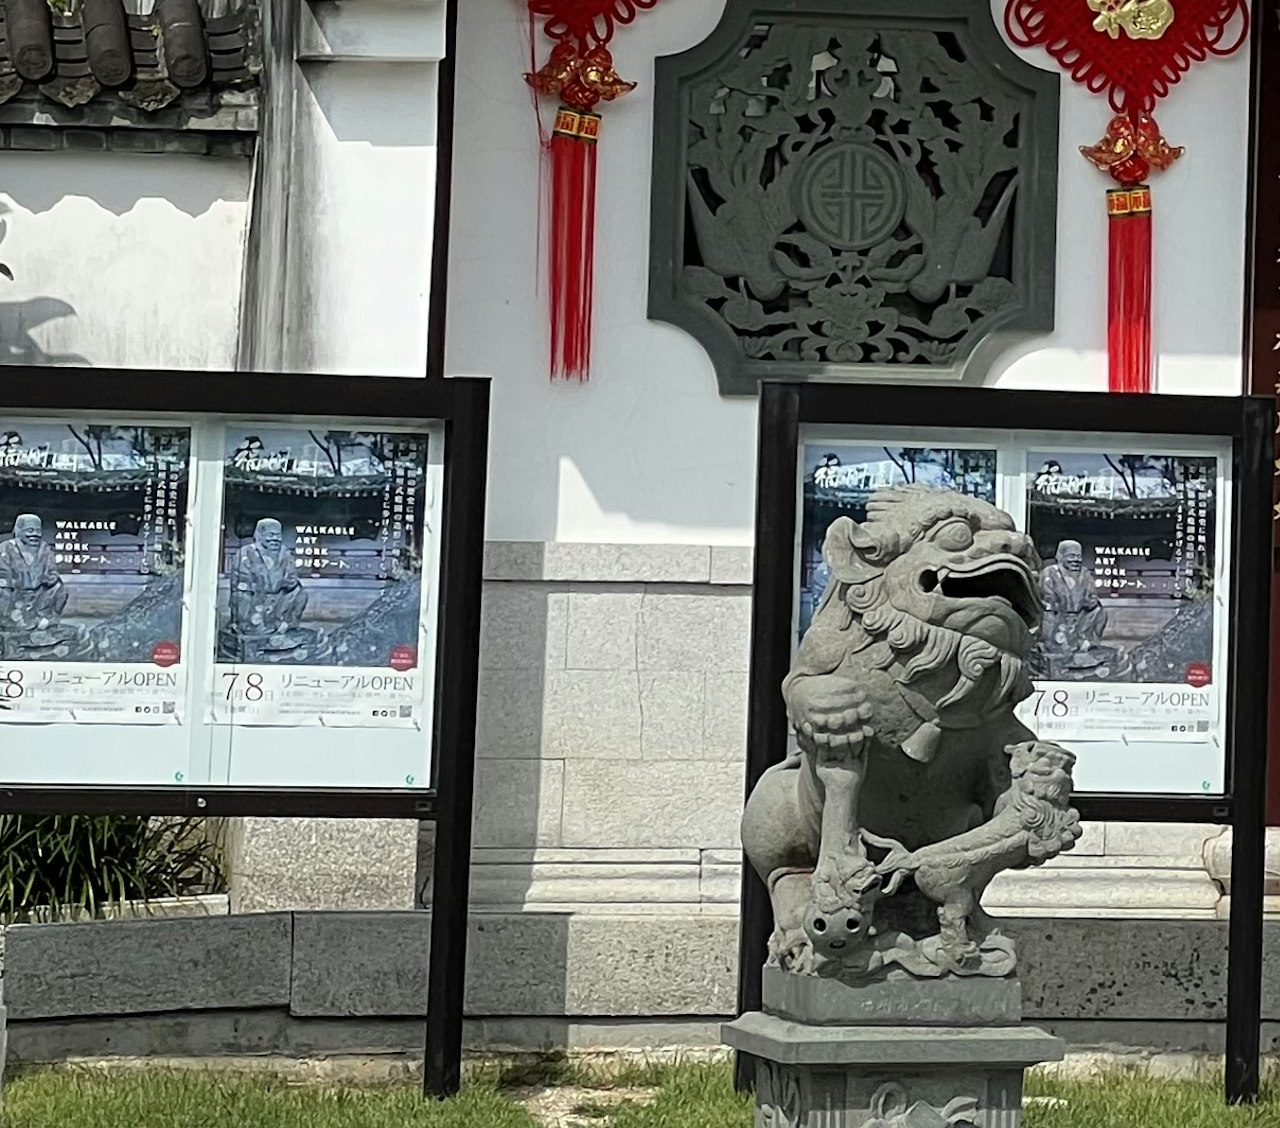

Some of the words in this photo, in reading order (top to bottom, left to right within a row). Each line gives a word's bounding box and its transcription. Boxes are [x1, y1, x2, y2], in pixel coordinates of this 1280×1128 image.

[55, 521, 117, 530] WALKABLE
[295, 526, 355, 535] WALKABLE
[55, 532, 78, 540] ART
[55, 543, 89, 551] WORK
[295, 547, 329, 556] WORK
[1095, 547, 1150, 556] WALKABLE
[1095, 557, 1116, 565] ART
[1095, 568, 1126, 576] WORK
